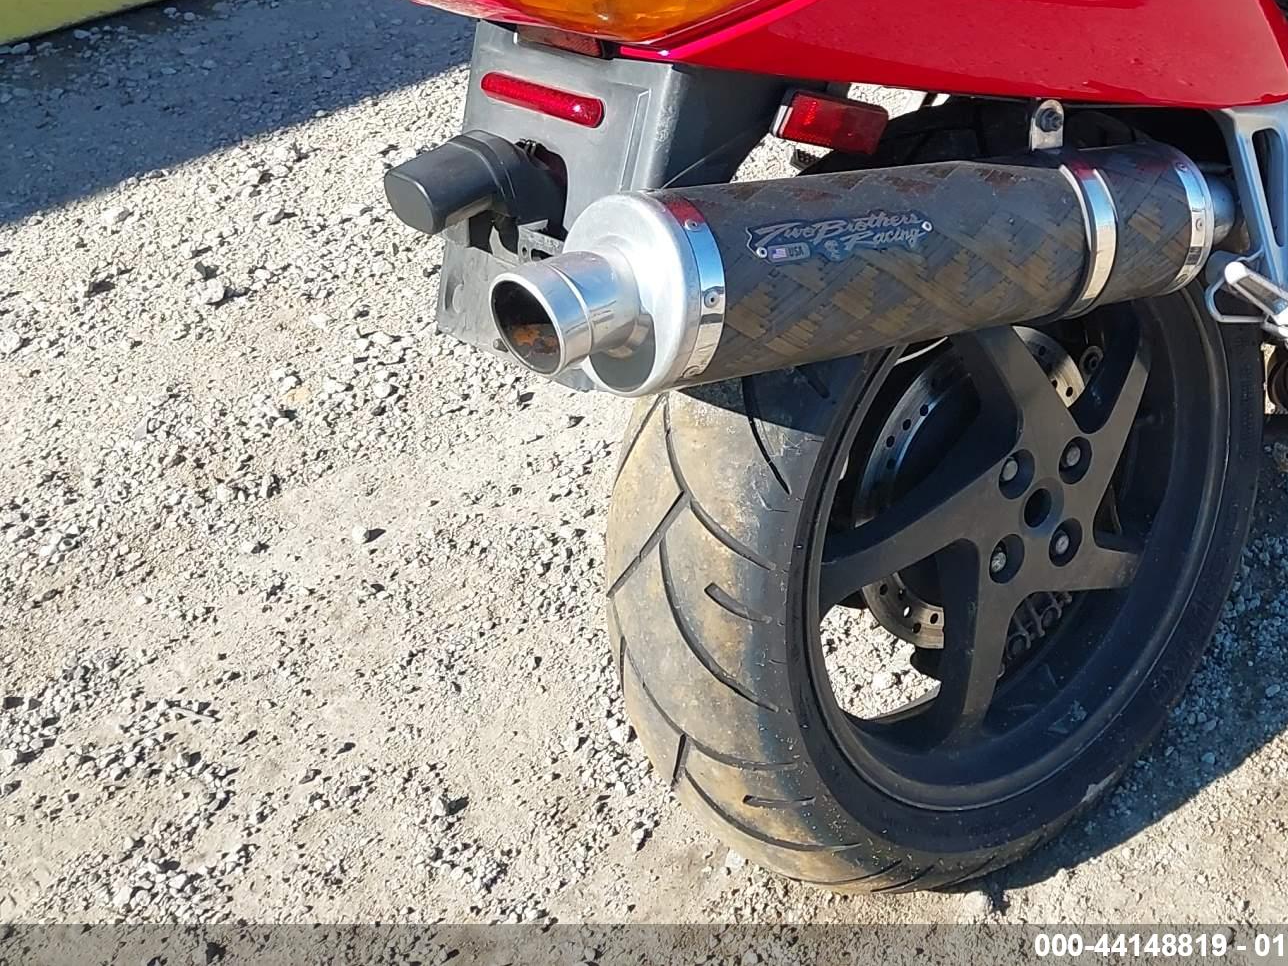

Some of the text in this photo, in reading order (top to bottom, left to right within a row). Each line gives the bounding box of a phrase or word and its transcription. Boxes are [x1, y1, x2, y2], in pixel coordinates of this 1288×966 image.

[754, 214, 922, 247] Two Brothers
[839, 228, 926, 252] Racing
